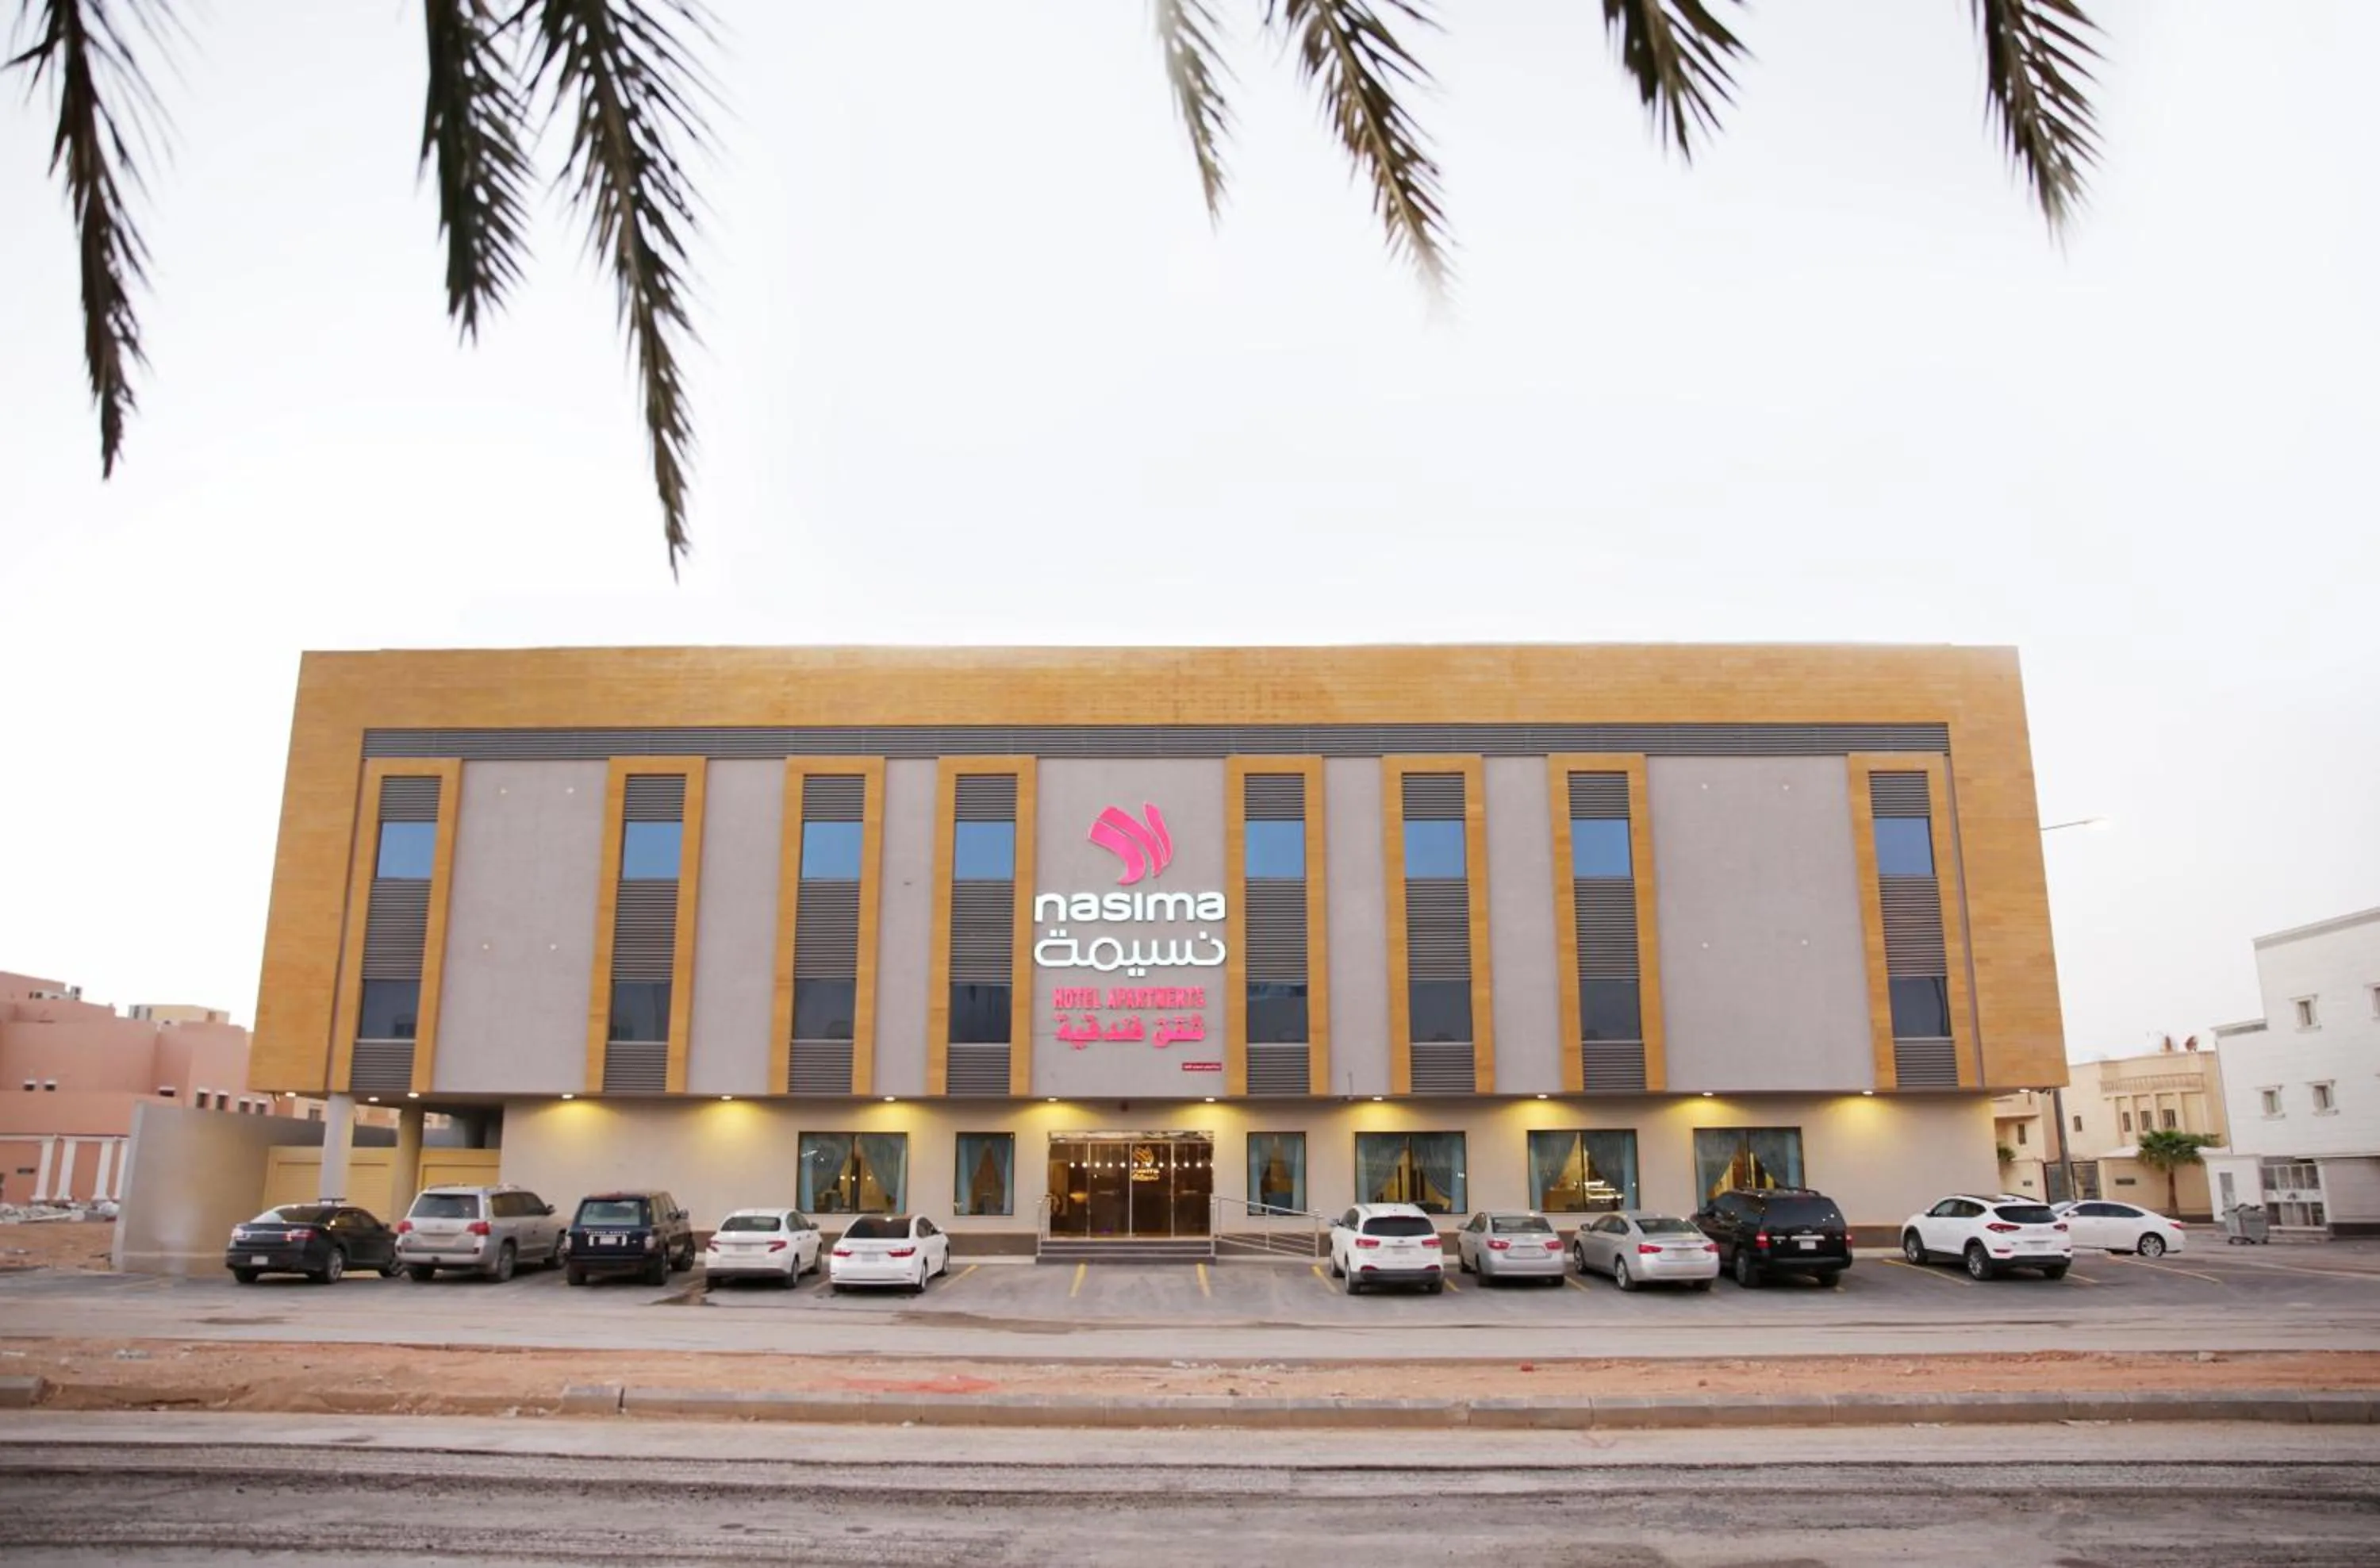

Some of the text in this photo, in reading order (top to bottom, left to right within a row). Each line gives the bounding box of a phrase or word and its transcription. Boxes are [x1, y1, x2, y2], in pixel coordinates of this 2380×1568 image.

[1034, 892, 1226, 921] nasima
[1034, 928, 1226, 978] نسيمة
[1053, 986, 1206, 1009] HOTEL APARTMENTS
[1054, 1013, 1205, 1051] شقق فندقية
